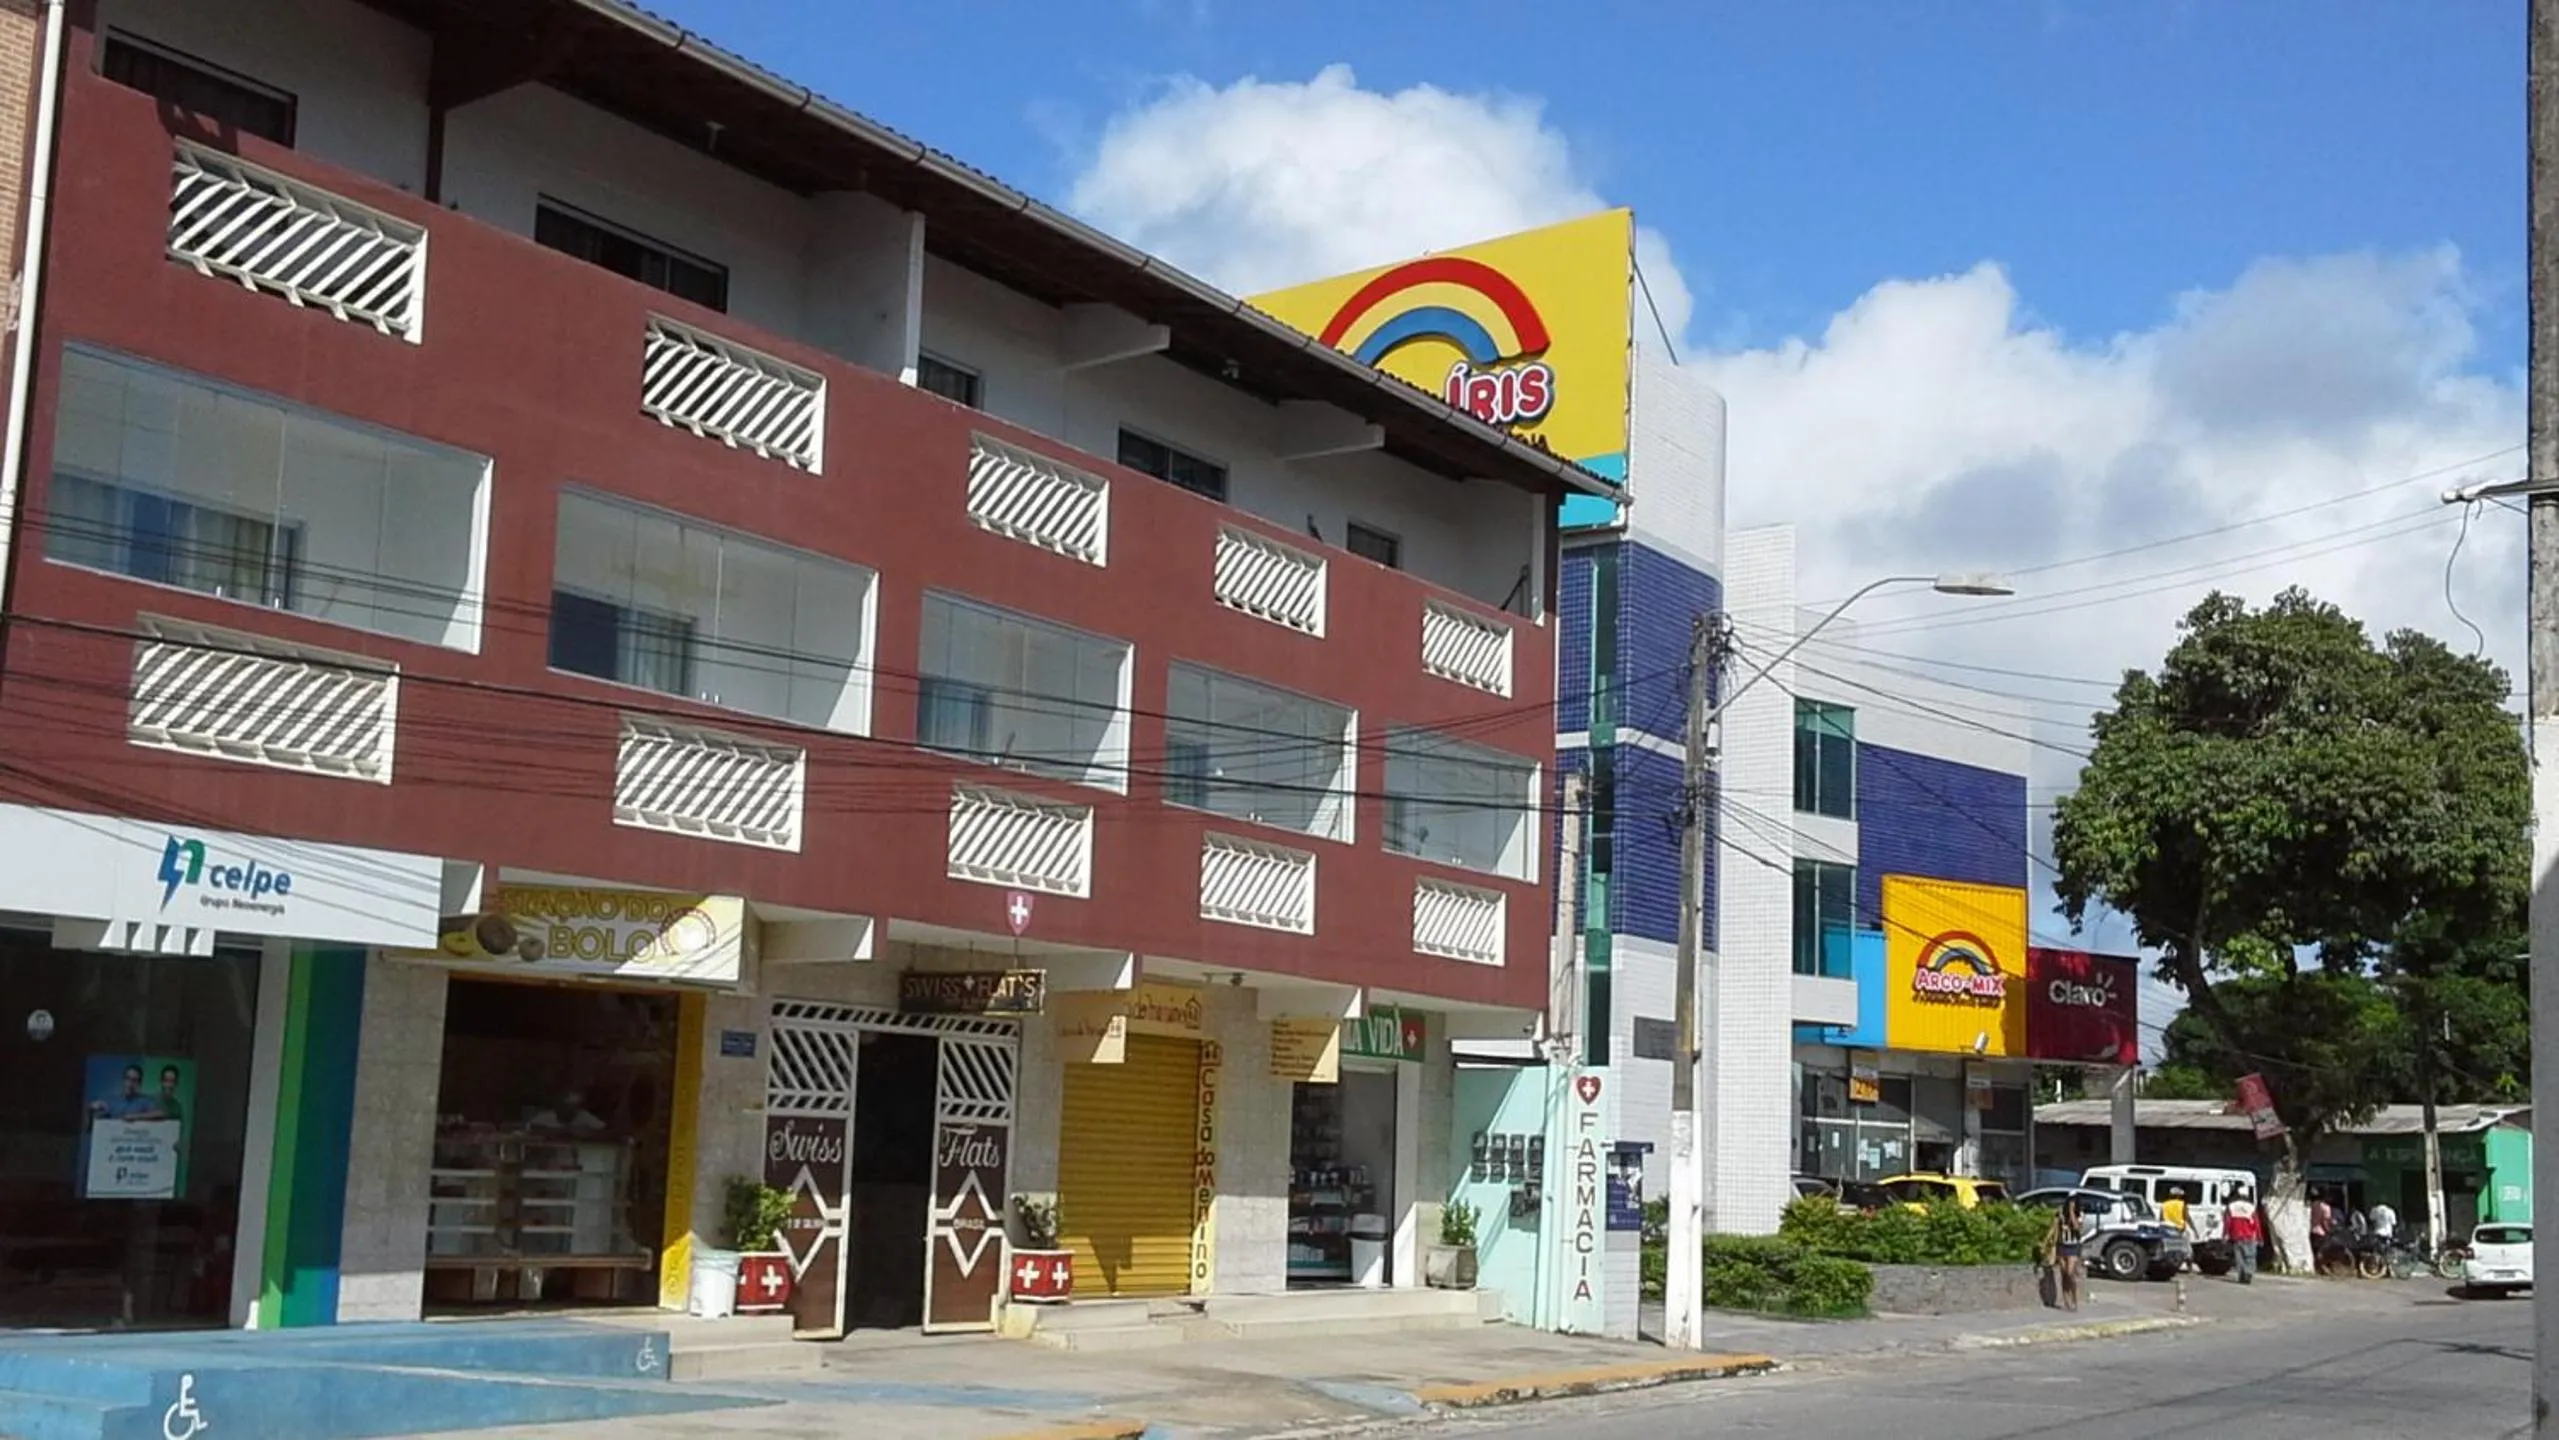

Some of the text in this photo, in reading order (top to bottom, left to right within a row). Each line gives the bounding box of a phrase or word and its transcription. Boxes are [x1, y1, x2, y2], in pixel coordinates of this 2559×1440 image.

[1445, 362, 1551, 424] ÍRIS
[209, 860, 292, 900] celpe
[626, 896, 668, 923] DO
[547, 924, 656, 963] BOLO
[905, 976, 961, 998] SWISS
[1915, 967, 2006, 998] ARCO-MIX
[2048, 979, 2107, 1008] Claro
[1201, 1068, 1215, 1142] Casa
[769, 1119, 842, 1165] Swiss
[939, 1123, 999, 1168] Flats
[1572, 1112, 1599, 1301] FARMACIA
